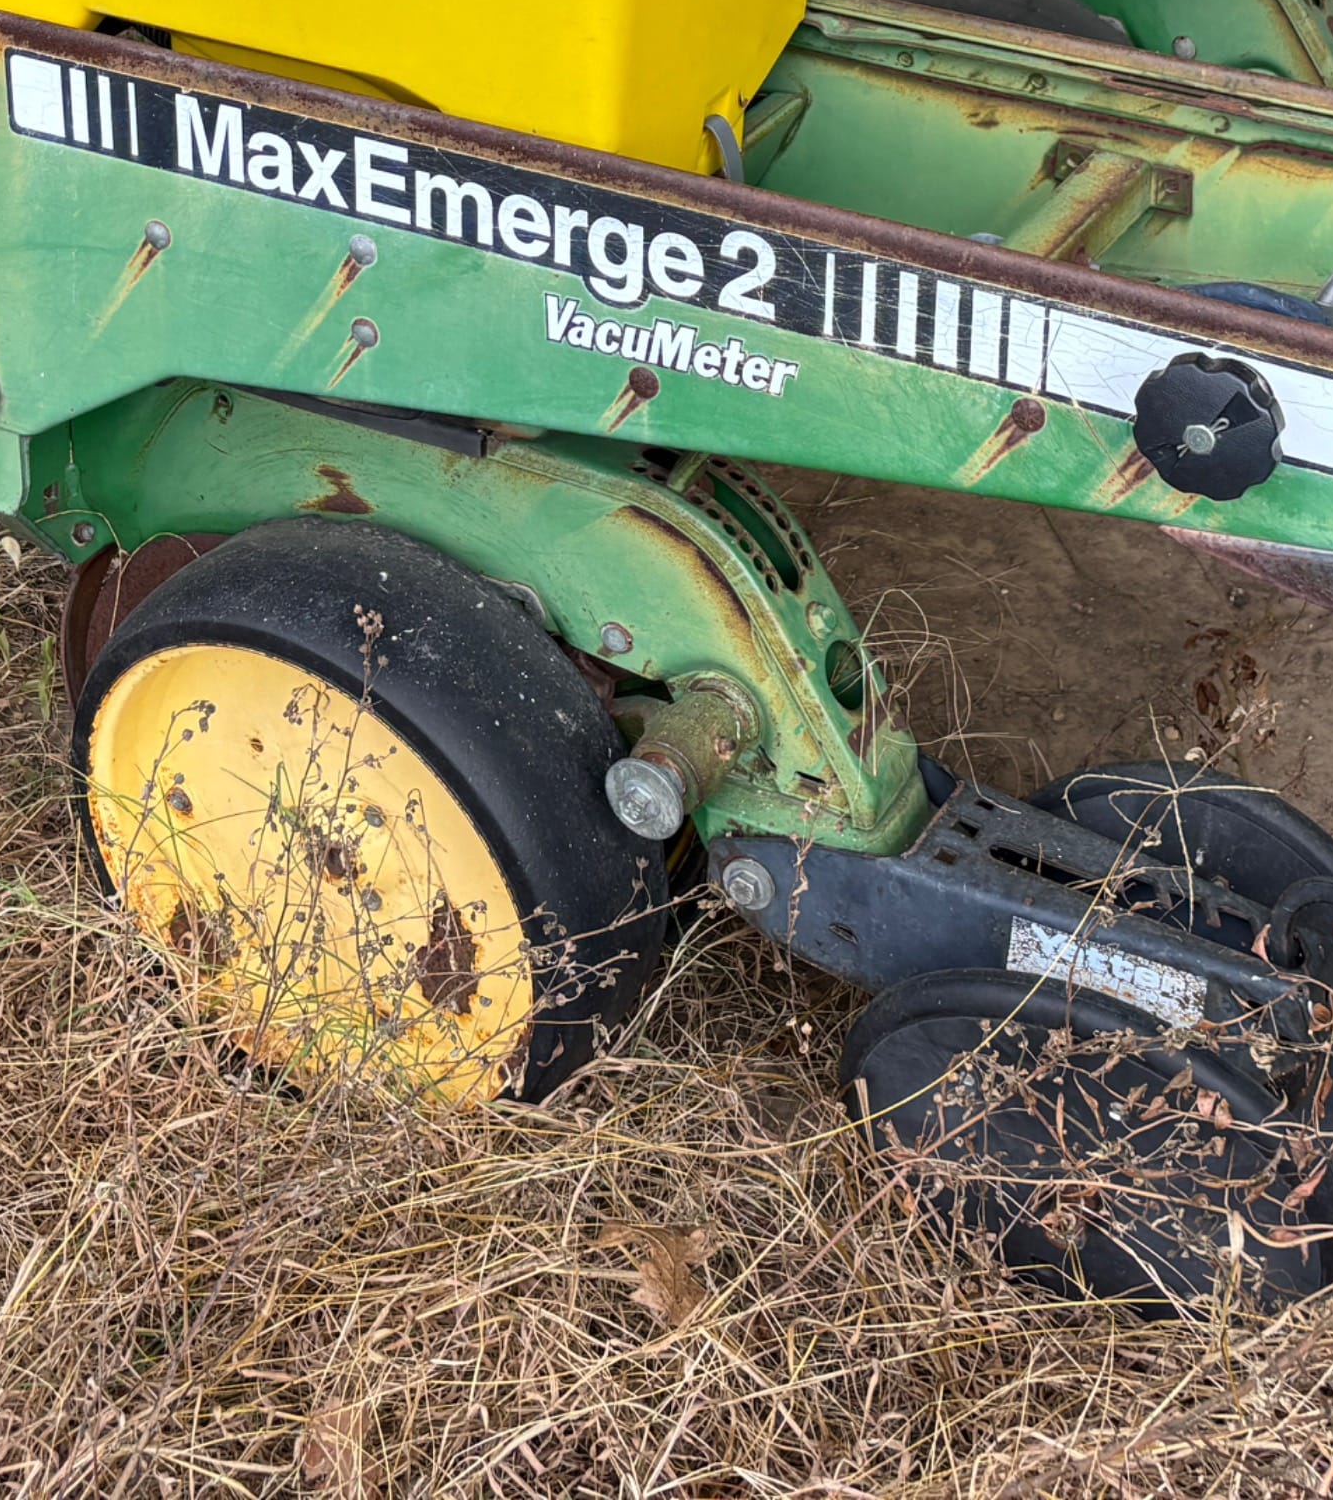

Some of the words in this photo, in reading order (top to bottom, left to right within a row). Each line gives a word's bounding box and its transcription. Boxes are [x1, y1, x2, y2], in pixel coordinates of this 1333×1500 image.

[174, 93, 706, 303] MaxEmerge
[718, 230, 777, 320] 2
[545, 292, 798, 397] VacuMeter
